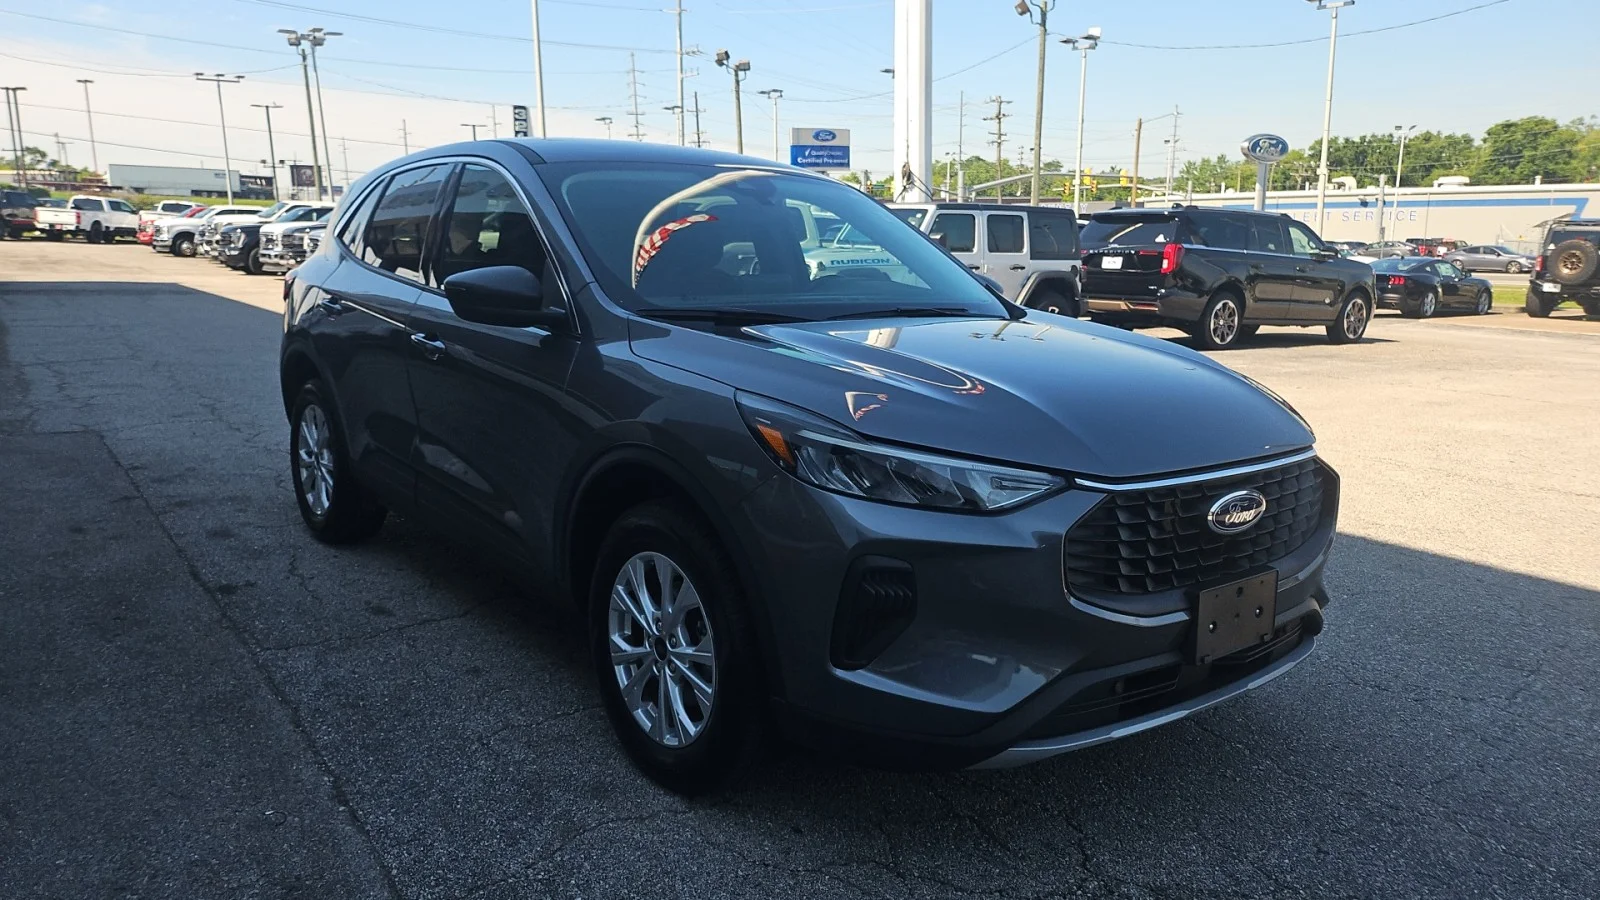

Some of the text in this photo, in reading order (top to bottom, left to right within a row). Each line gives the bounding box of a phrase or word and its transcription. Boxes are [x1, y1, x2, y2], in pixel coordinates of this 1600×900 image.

[1256, 138, 1282, 157] Ford
[1342, 210, 1417, 222] SERICE
[831, 258, 890, 266] RUBICON
[1219, 501, 1257, 525] Ford
